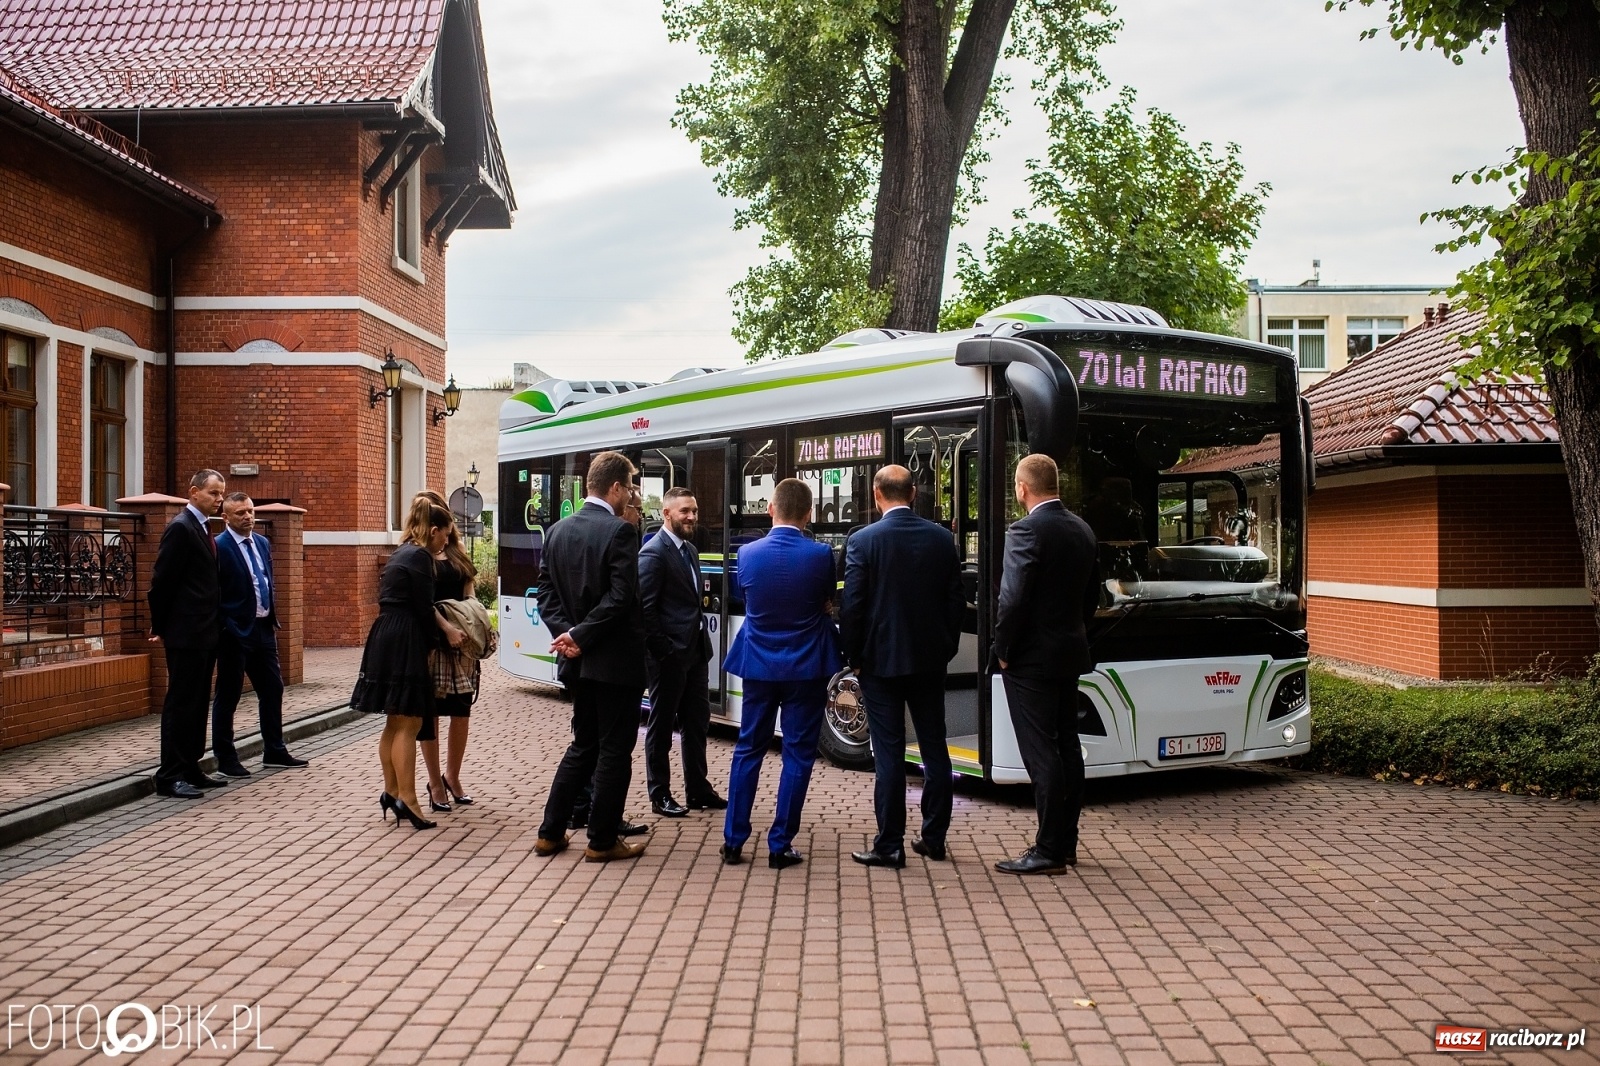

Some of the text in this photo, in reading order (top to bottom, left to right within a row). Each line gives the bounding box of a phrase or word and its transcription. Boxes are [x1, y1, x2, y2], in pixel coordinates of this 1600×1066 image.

[1078, 350, 1247, 396] 70 lat RAFAKO
[798, 432, 882, 462] 70 lat RAFAKO
[1204, 671, 1241, 686] RAFAKO
[1168, 735, 1222, 754] S1 139B
